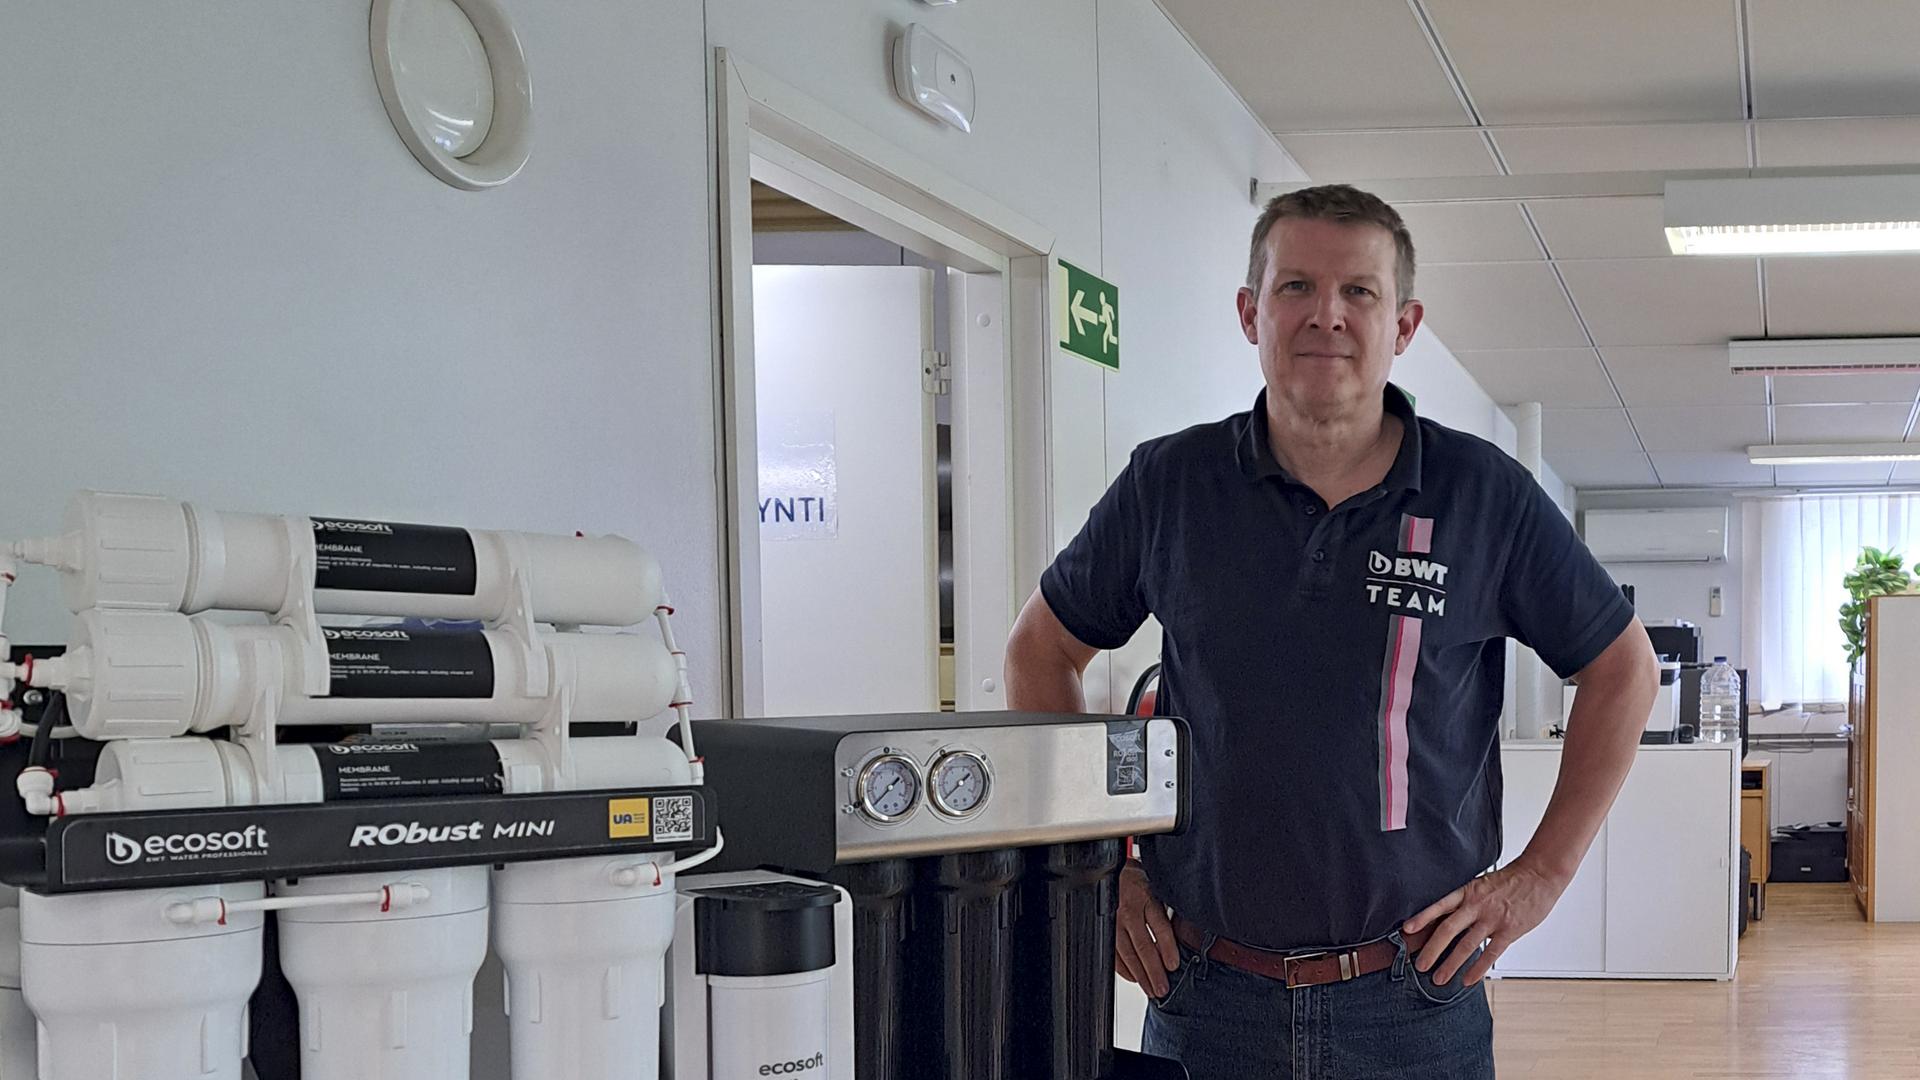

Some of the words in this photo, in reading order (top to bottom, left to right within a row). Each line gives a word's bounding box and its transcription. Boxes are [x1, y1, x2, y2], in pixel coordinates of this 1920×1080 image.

[1394, 557, 1448, 585] BWT
[1366, 585, 1446, 616] TEAM
[338, 765, 391, 774] MEMBRANE
[613, 814, 632, 825] UA
[144, 824, 269, 855] ecosoft
[349, 821, 484, 847] RObust
[493, 820, 555, 839] MINI
[759, 1052, 823, 1076] ecosoft
